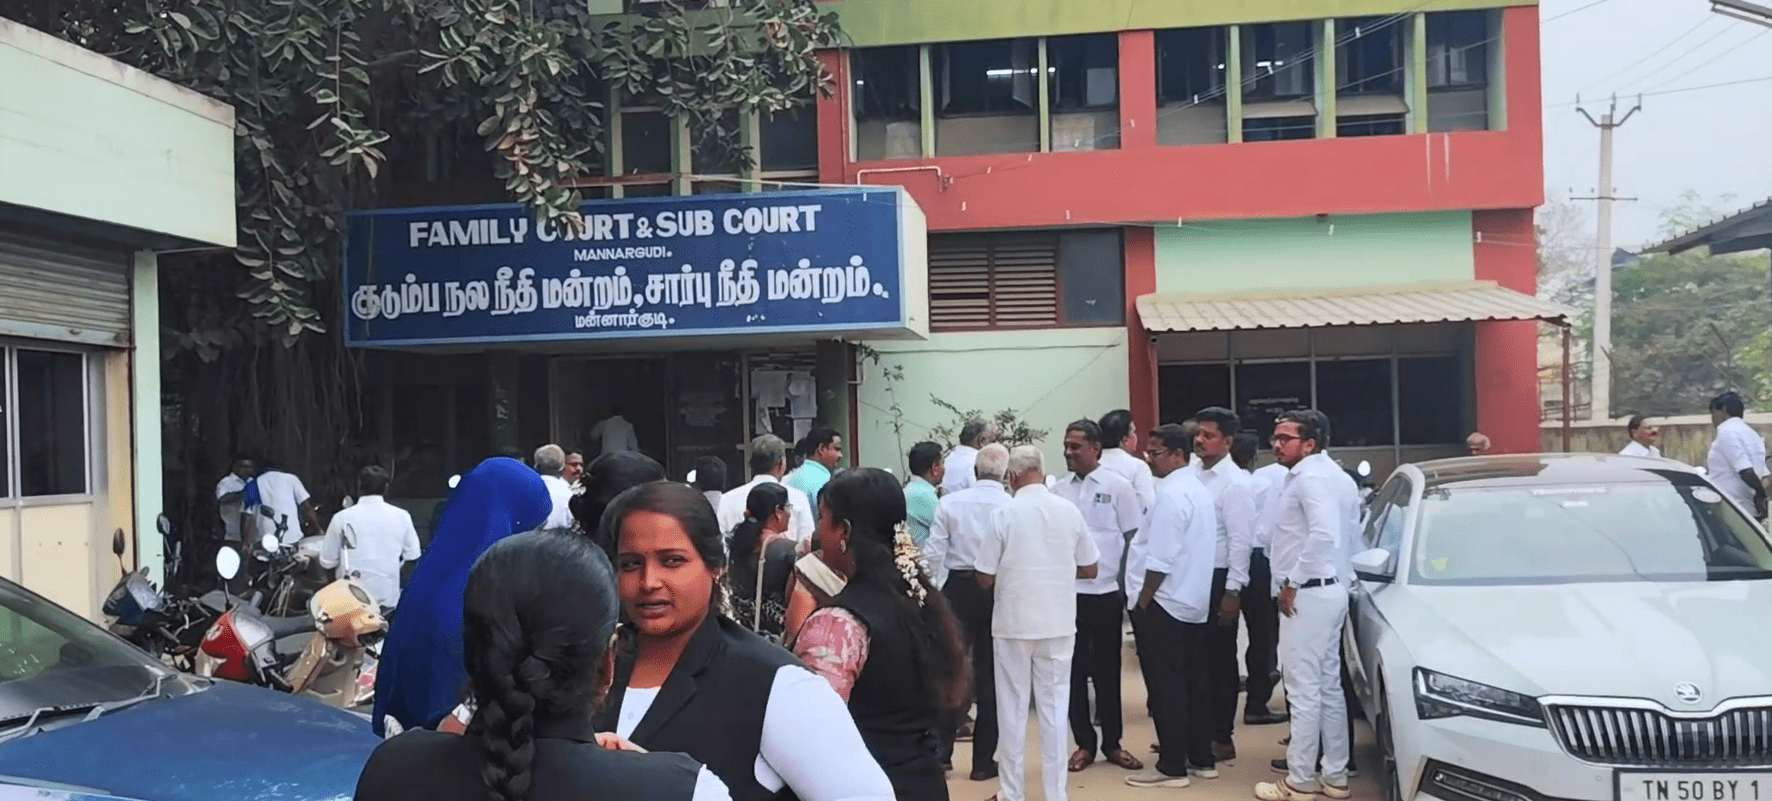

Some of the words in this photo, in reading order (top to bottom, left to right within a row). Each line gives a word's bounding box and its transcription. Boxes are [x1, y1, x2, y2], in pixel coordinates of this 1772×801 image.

[409, 217, 528, 247] FAMILY
[656, 209, 714, 237] SUB
[723, 204, 822, 235] COURT
[574, 246, 672, 262] MANNARGUDI.
[1643, 780, 1669, 800] TN
[1678, 780, 1703, 800] 50
[1713, 780, 1738, 800] BY
[1751, 780, 1758, 800] 1
